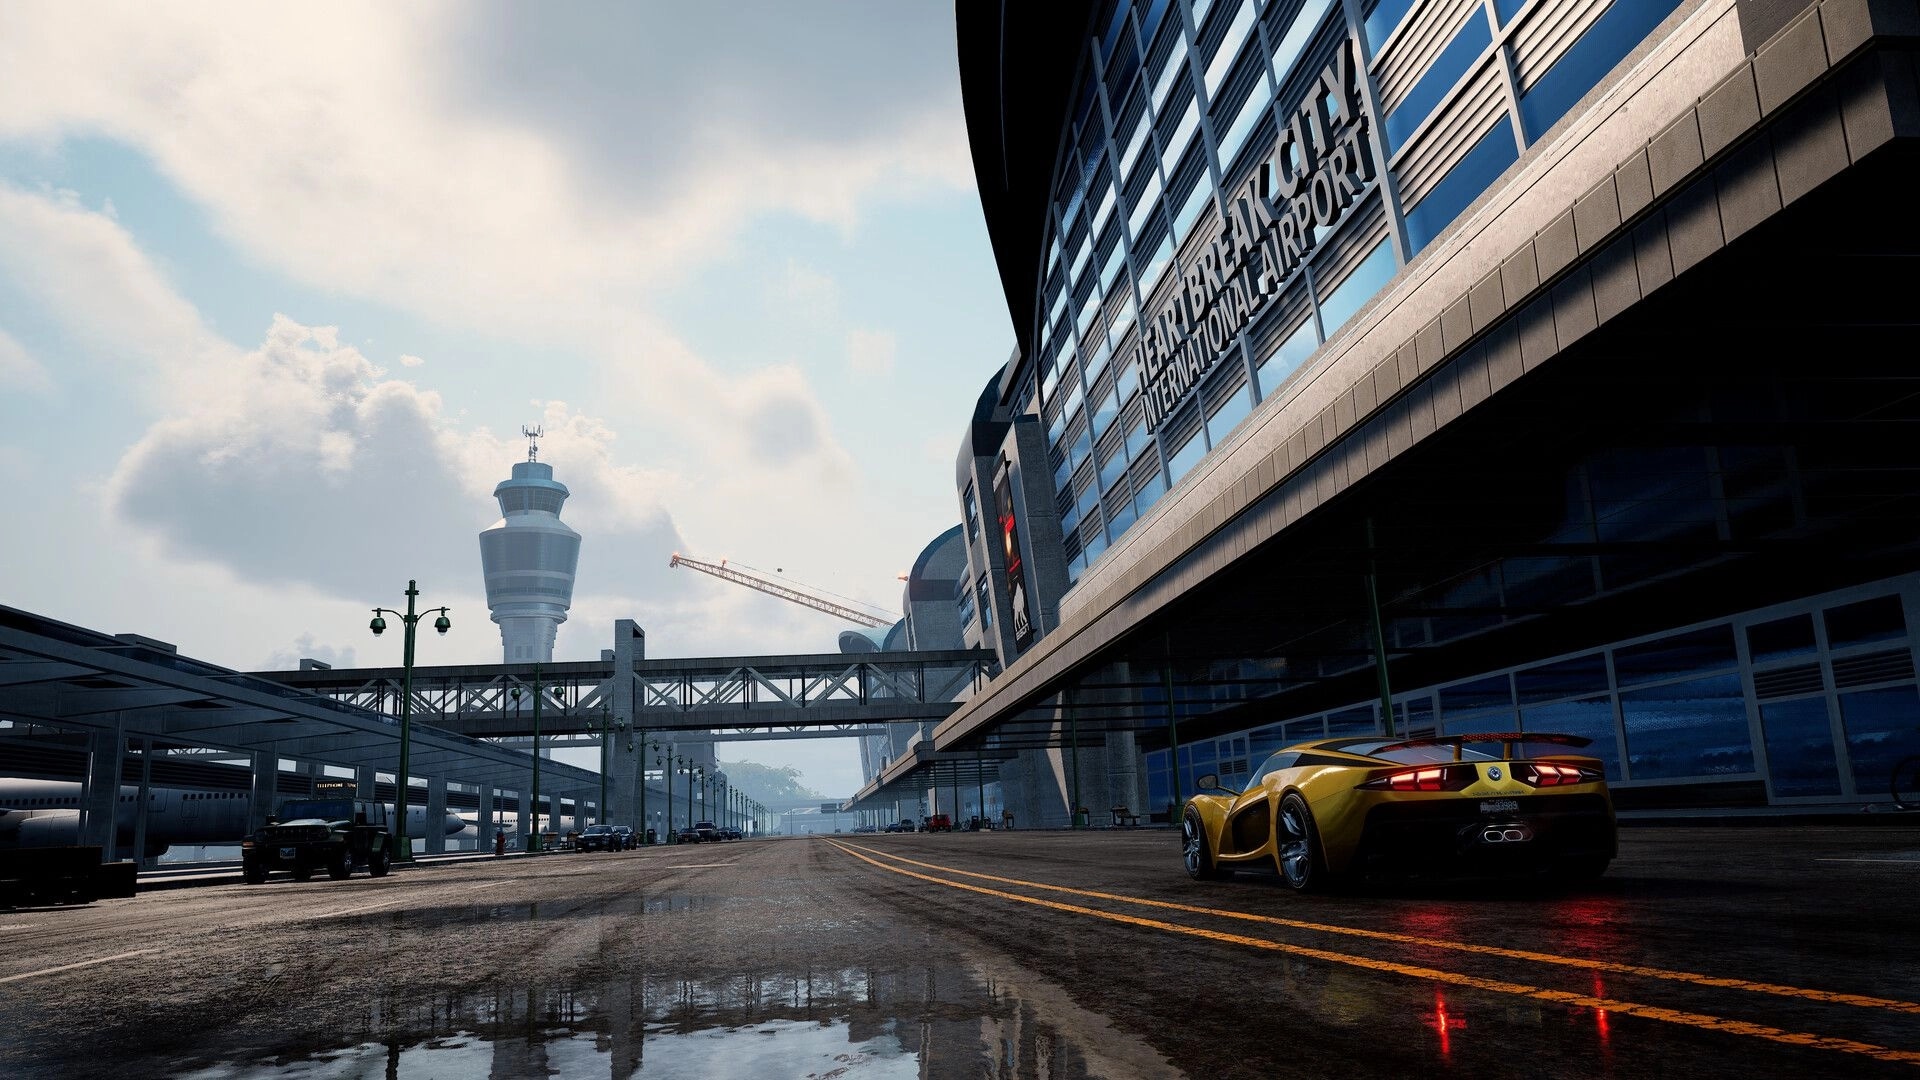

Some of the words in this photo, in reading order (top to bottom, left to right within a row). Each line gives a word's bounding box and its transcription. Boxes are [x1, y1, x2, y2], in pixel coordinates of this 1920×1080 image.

[1135, 163, 1276, 387] HEARTBREAK
[1274, 38, 1358, 198] CITY
[1140, 268, 1264, 434] INTERNATIONAL
[1261, 117, 1373, 291] AIRPORT
